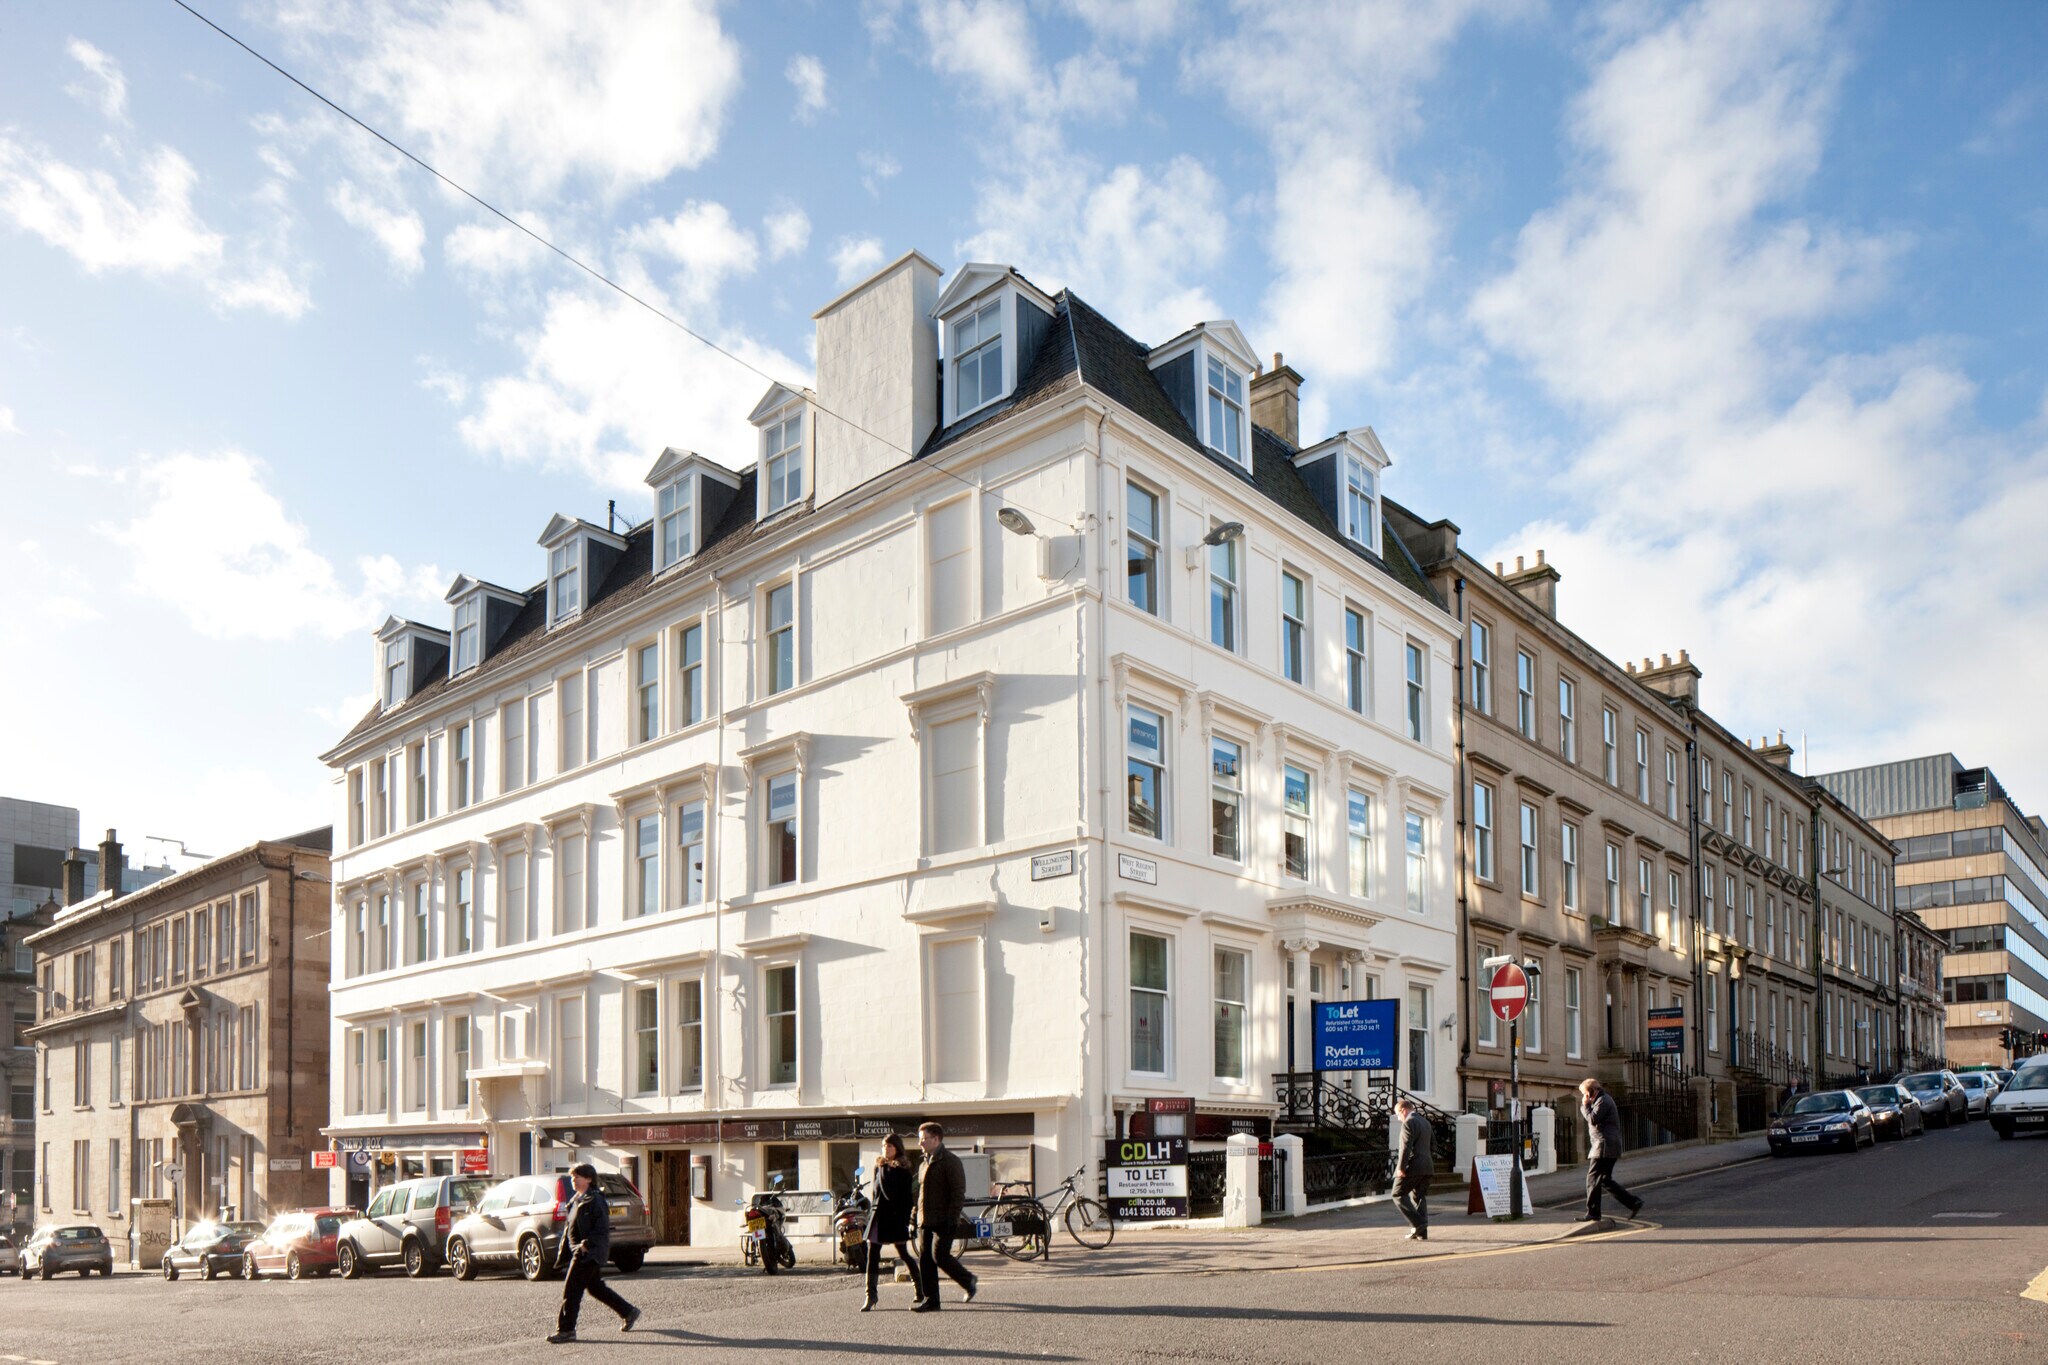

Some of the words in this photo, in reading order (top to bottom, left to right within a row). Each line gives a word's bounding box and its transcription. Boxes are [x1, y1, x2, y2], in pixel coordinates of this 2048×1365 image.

[1034, 855, 1070, 866] WELLINGTON
[1121, 857, 1135, 866] WEST
[1135, 861, 1155, 871] REGENT
[1042, 865, 1062, 873] STREET
[1130, 867, 1147, 878] STREET
[1326, 1059, 1341, 1067] 0141
[1360, 1058, 1381, 1066] 3838
[343, 1137, 363, 1150] NEWS
[365, 1137, 382, 1149] BOX
[1121, 1141, 1171, 1160] CDLH
[1125, 1169, 1141, 1180] TO
[1146, 1169, 1167, 1180] LET
[1128, 1198, 1166, 1206] cdlh.co.uk
[1120, 1207, 1138, 1216] 0141
[1140, 1207, 1154, 1216] 331
[1156, 1207, 1175, 1216] 0650
[754, 1230, 762, 1238] L
[980, 1225, 990, 1237] P
